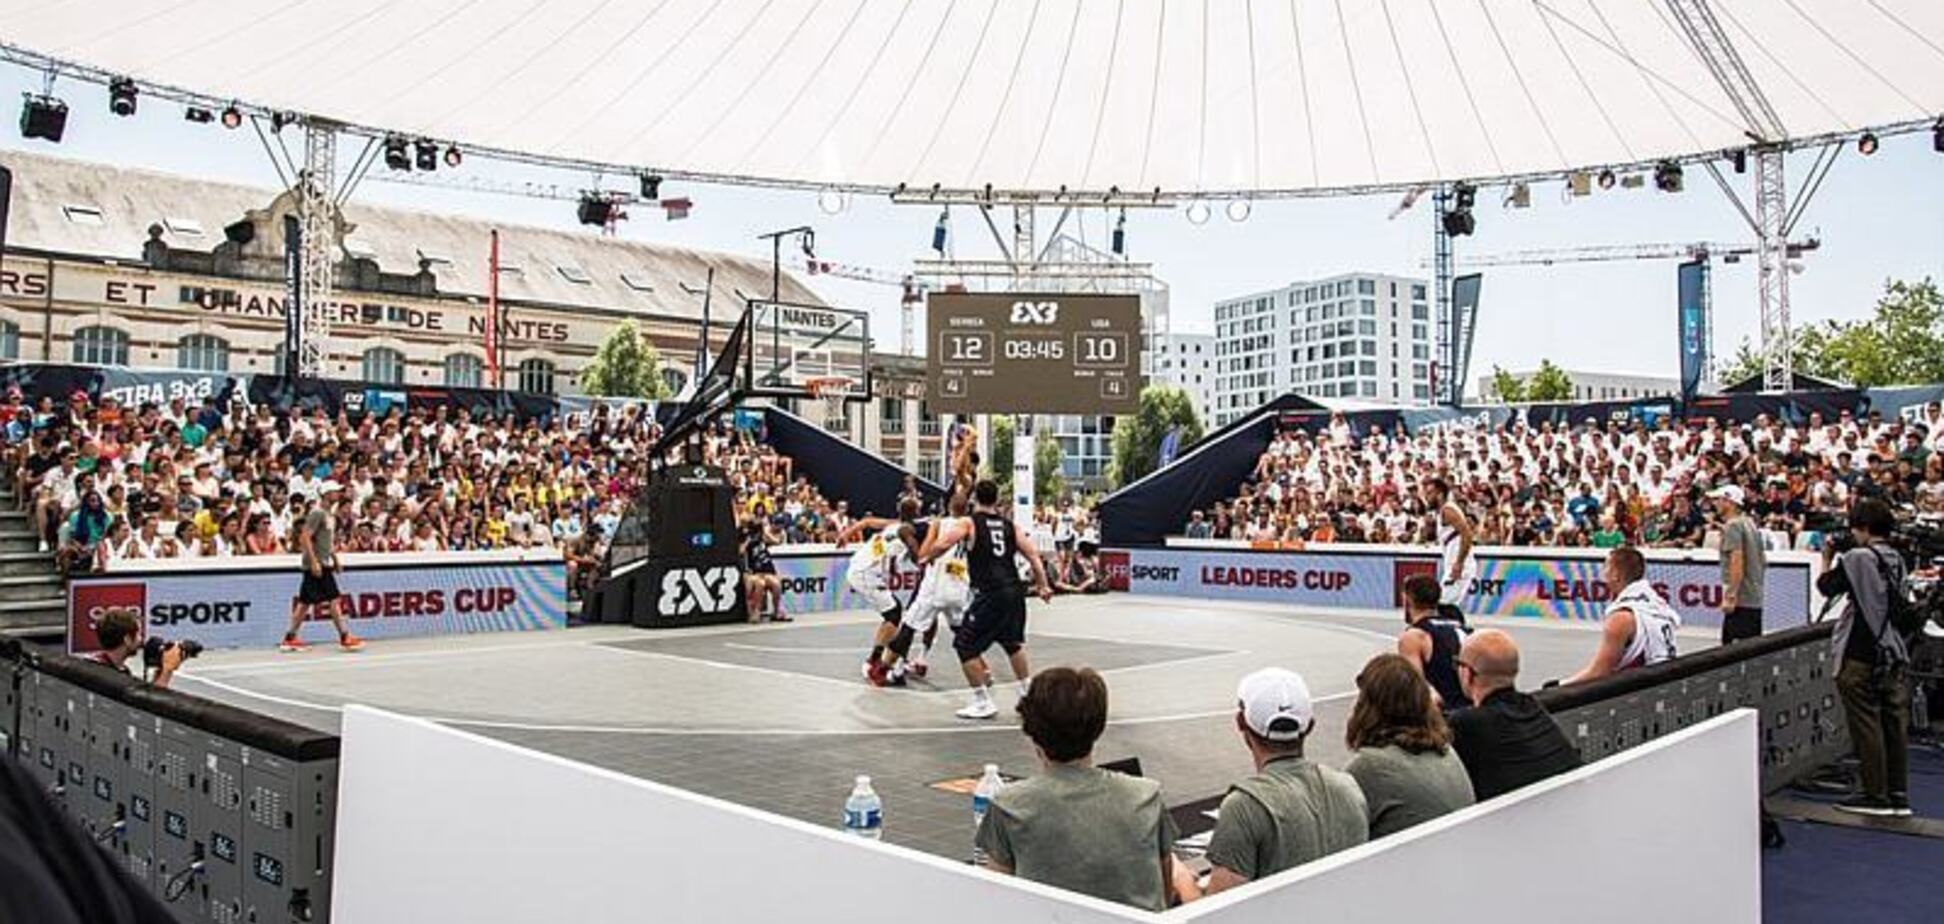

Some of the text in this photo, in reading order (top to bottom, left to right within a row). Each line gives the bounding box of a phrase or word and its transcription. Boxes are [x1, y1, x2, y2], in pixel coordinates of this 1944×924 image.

[106, 281, 156, 305] ET
[408, 311, 443, 330] DE
[469, 316, 569, 342] NNTES
[783, 309, 836, 328] NANTES
[951, 336, 983, 360] 12
[1004, 340, 1064, 359] 03:45
[1085, 338, 1117, 360] 10
[991, 529, 1006, 557] 5
[1132, 564, 1180, 582] SPORT
[1201, 565, 1351, 591] LEADERS CUP
[781, 577, 827, 594] PORT
[1467, 579, 1506, 597] ORT
[1537, 578, 1723, 607] LEADS CU
[454, 587, 516, 613] CUP
[150, 602, 250, 626] SPORT
